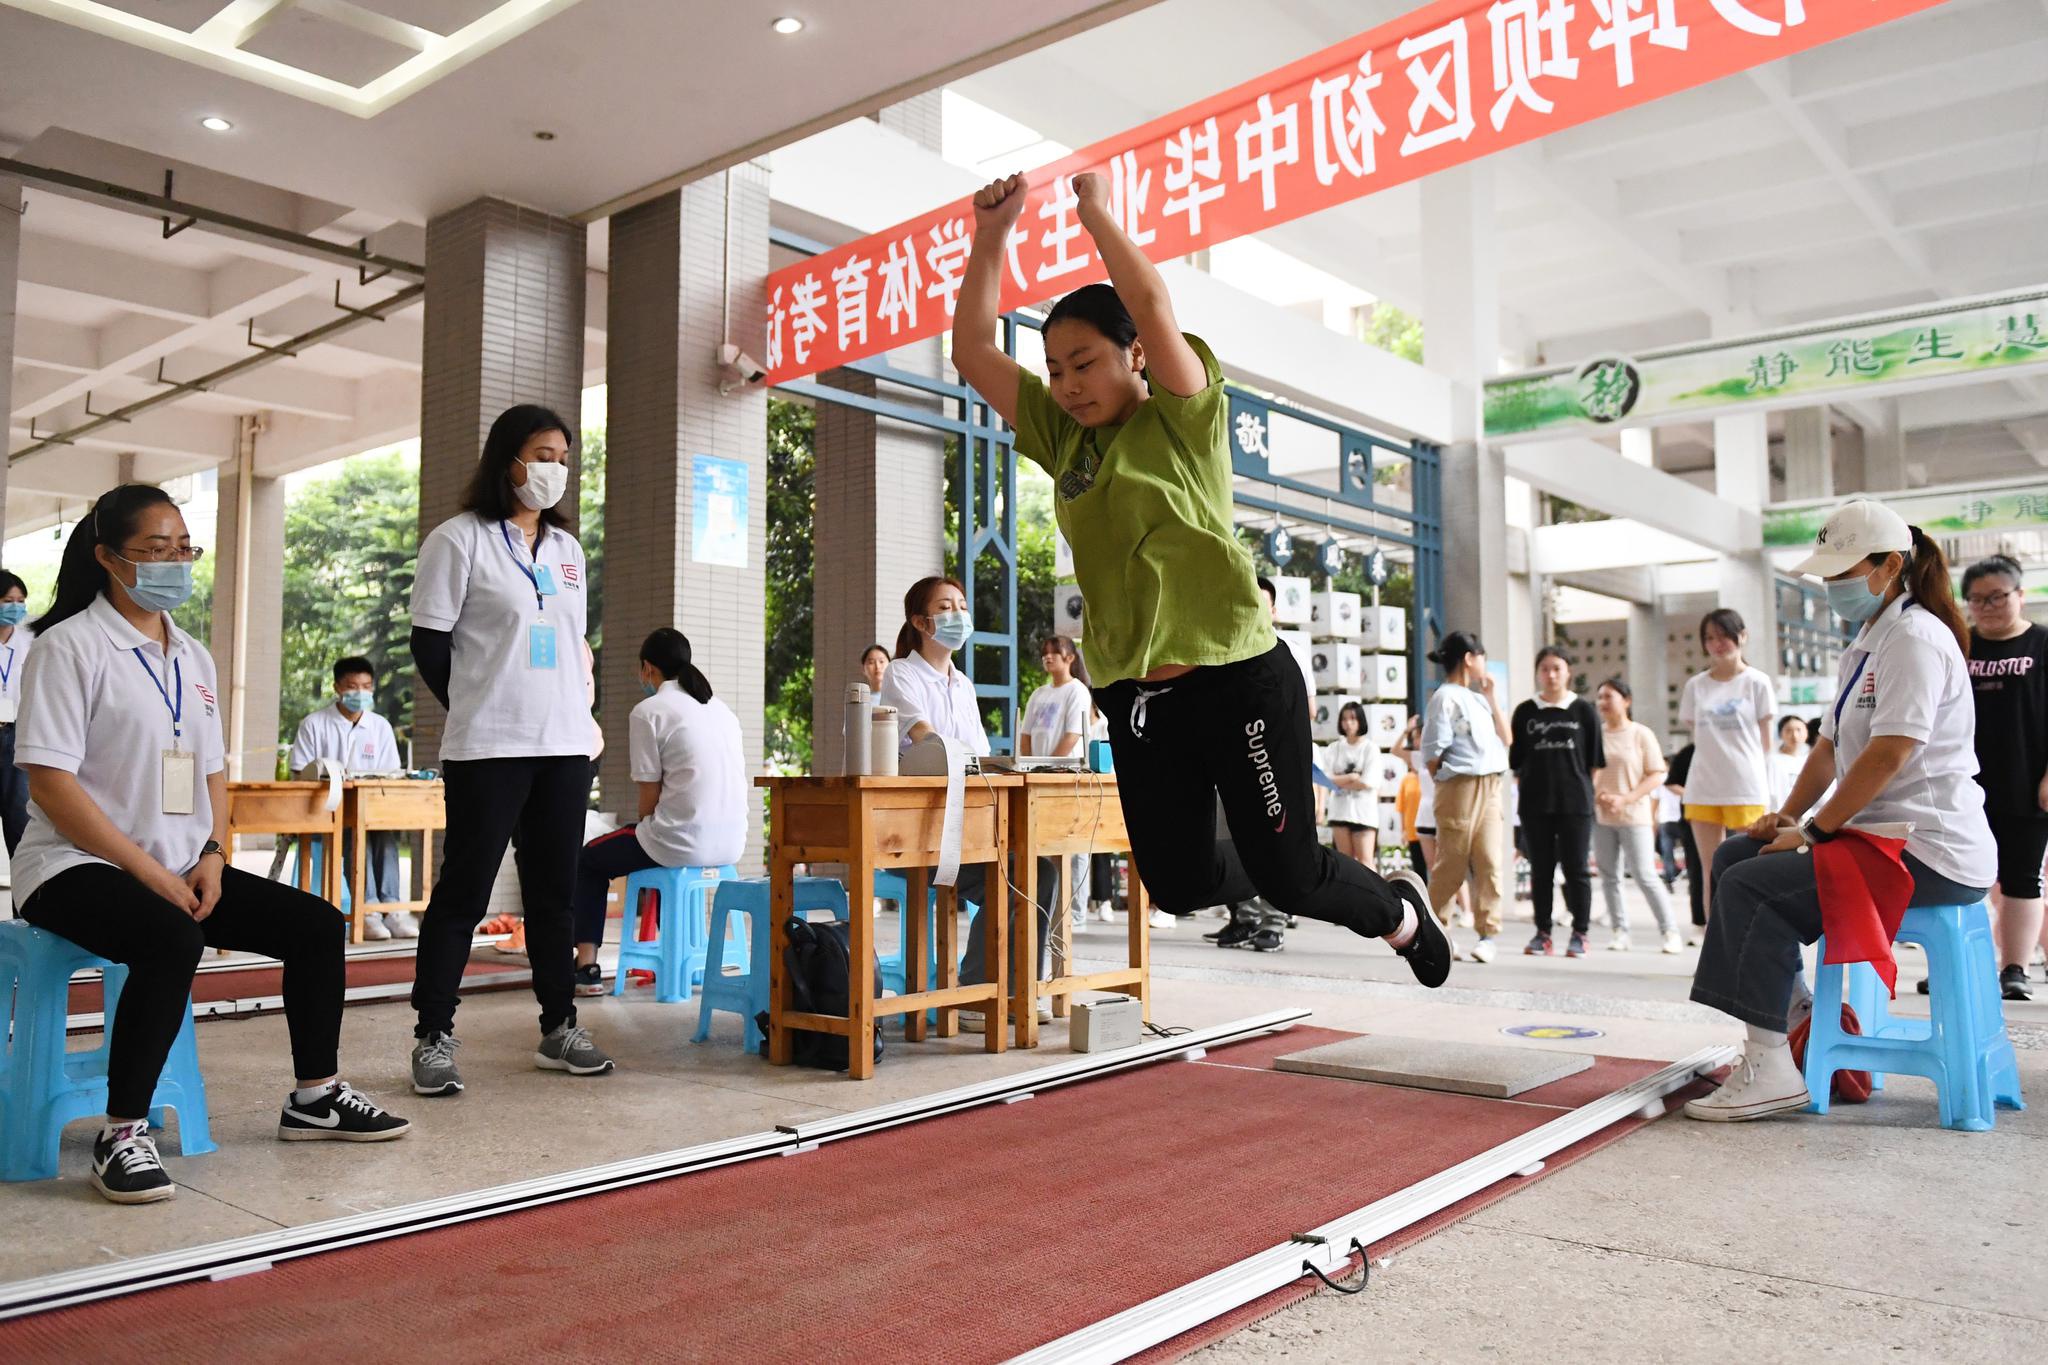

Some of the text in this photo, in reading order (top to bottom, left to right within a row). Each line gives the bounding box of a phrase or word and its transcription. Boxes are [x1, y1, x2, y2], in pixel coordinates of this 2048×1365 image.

[1235, 411, 1269, 459] 敬
[1997, 656, 2034, 676] STOP
[1245, 719, 1282, 817] Supreme
